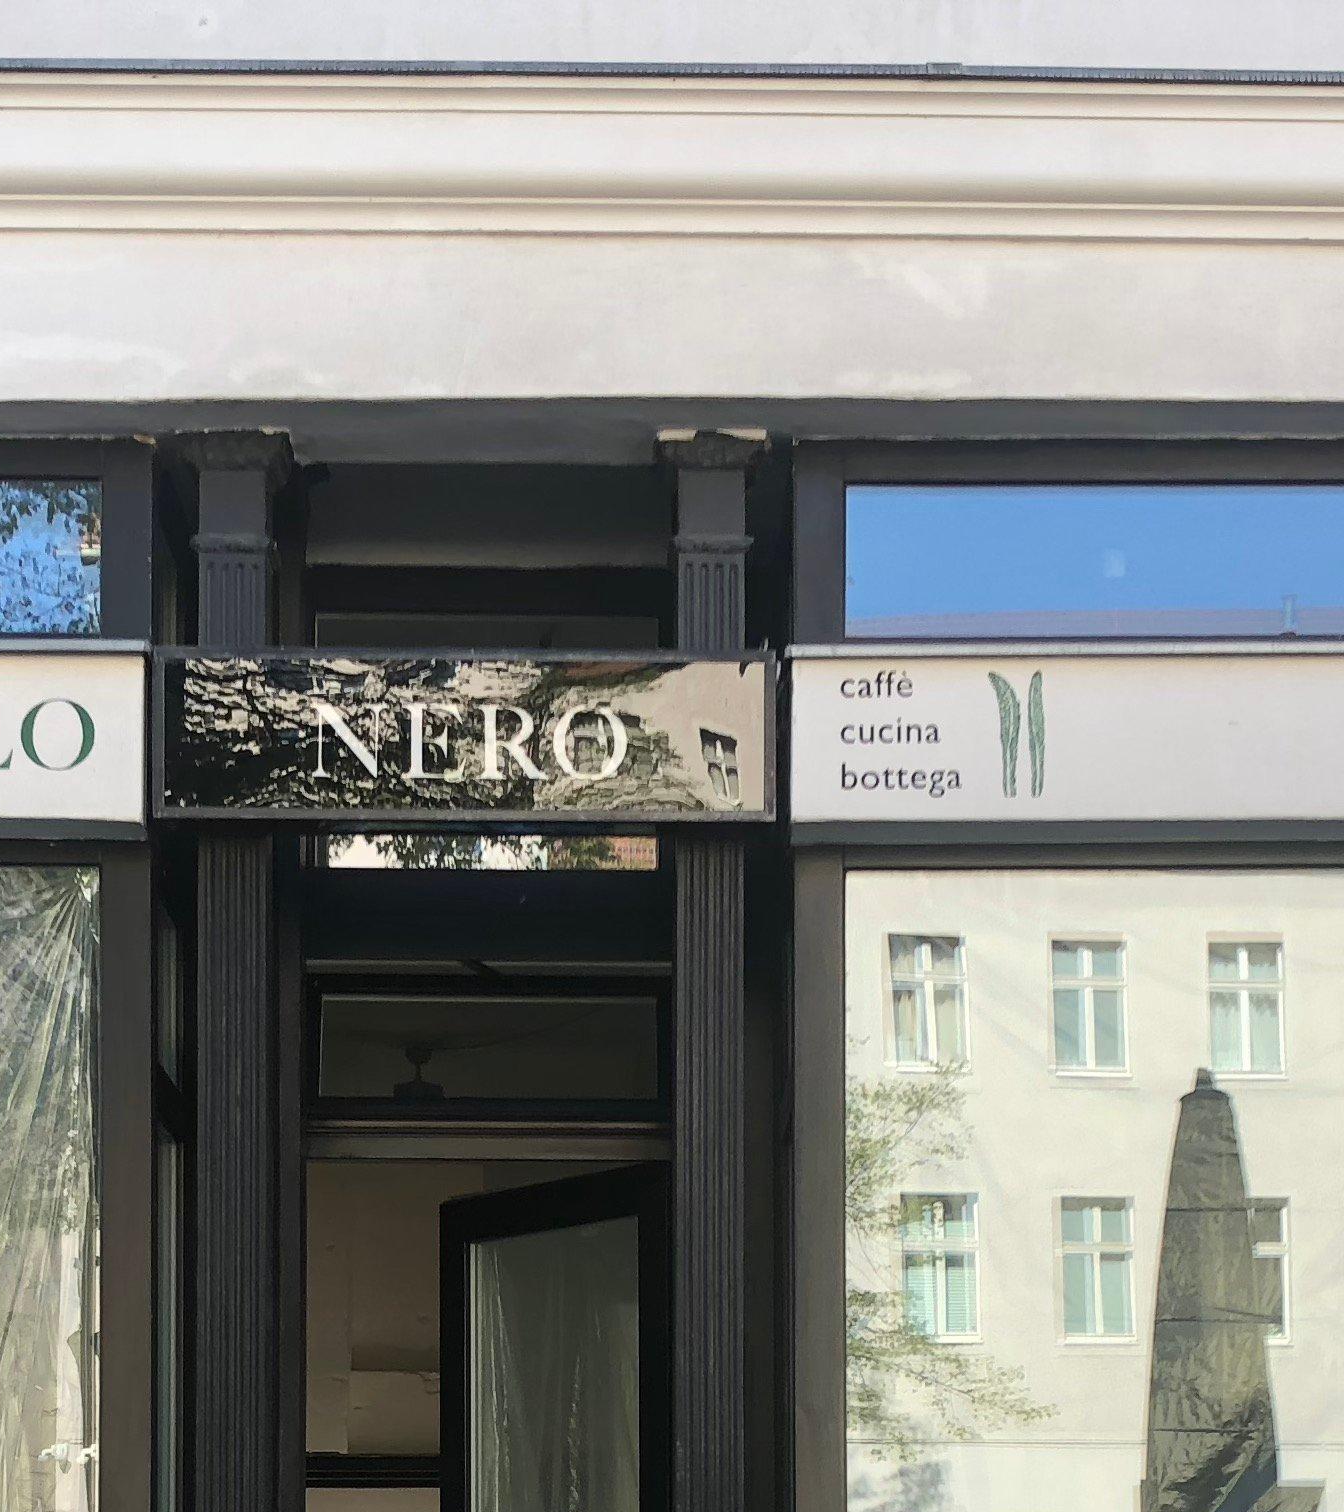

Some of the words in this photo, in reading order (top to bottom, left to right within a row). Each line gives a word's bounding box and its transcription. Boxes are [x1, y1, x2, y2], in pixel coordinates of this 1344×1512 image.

[840, 669, 914, 698] caffè
[309, 702, 628, 781] NERO
[840, 717, 941, 744] cucina
[840, 761, 963, 799] bottega
